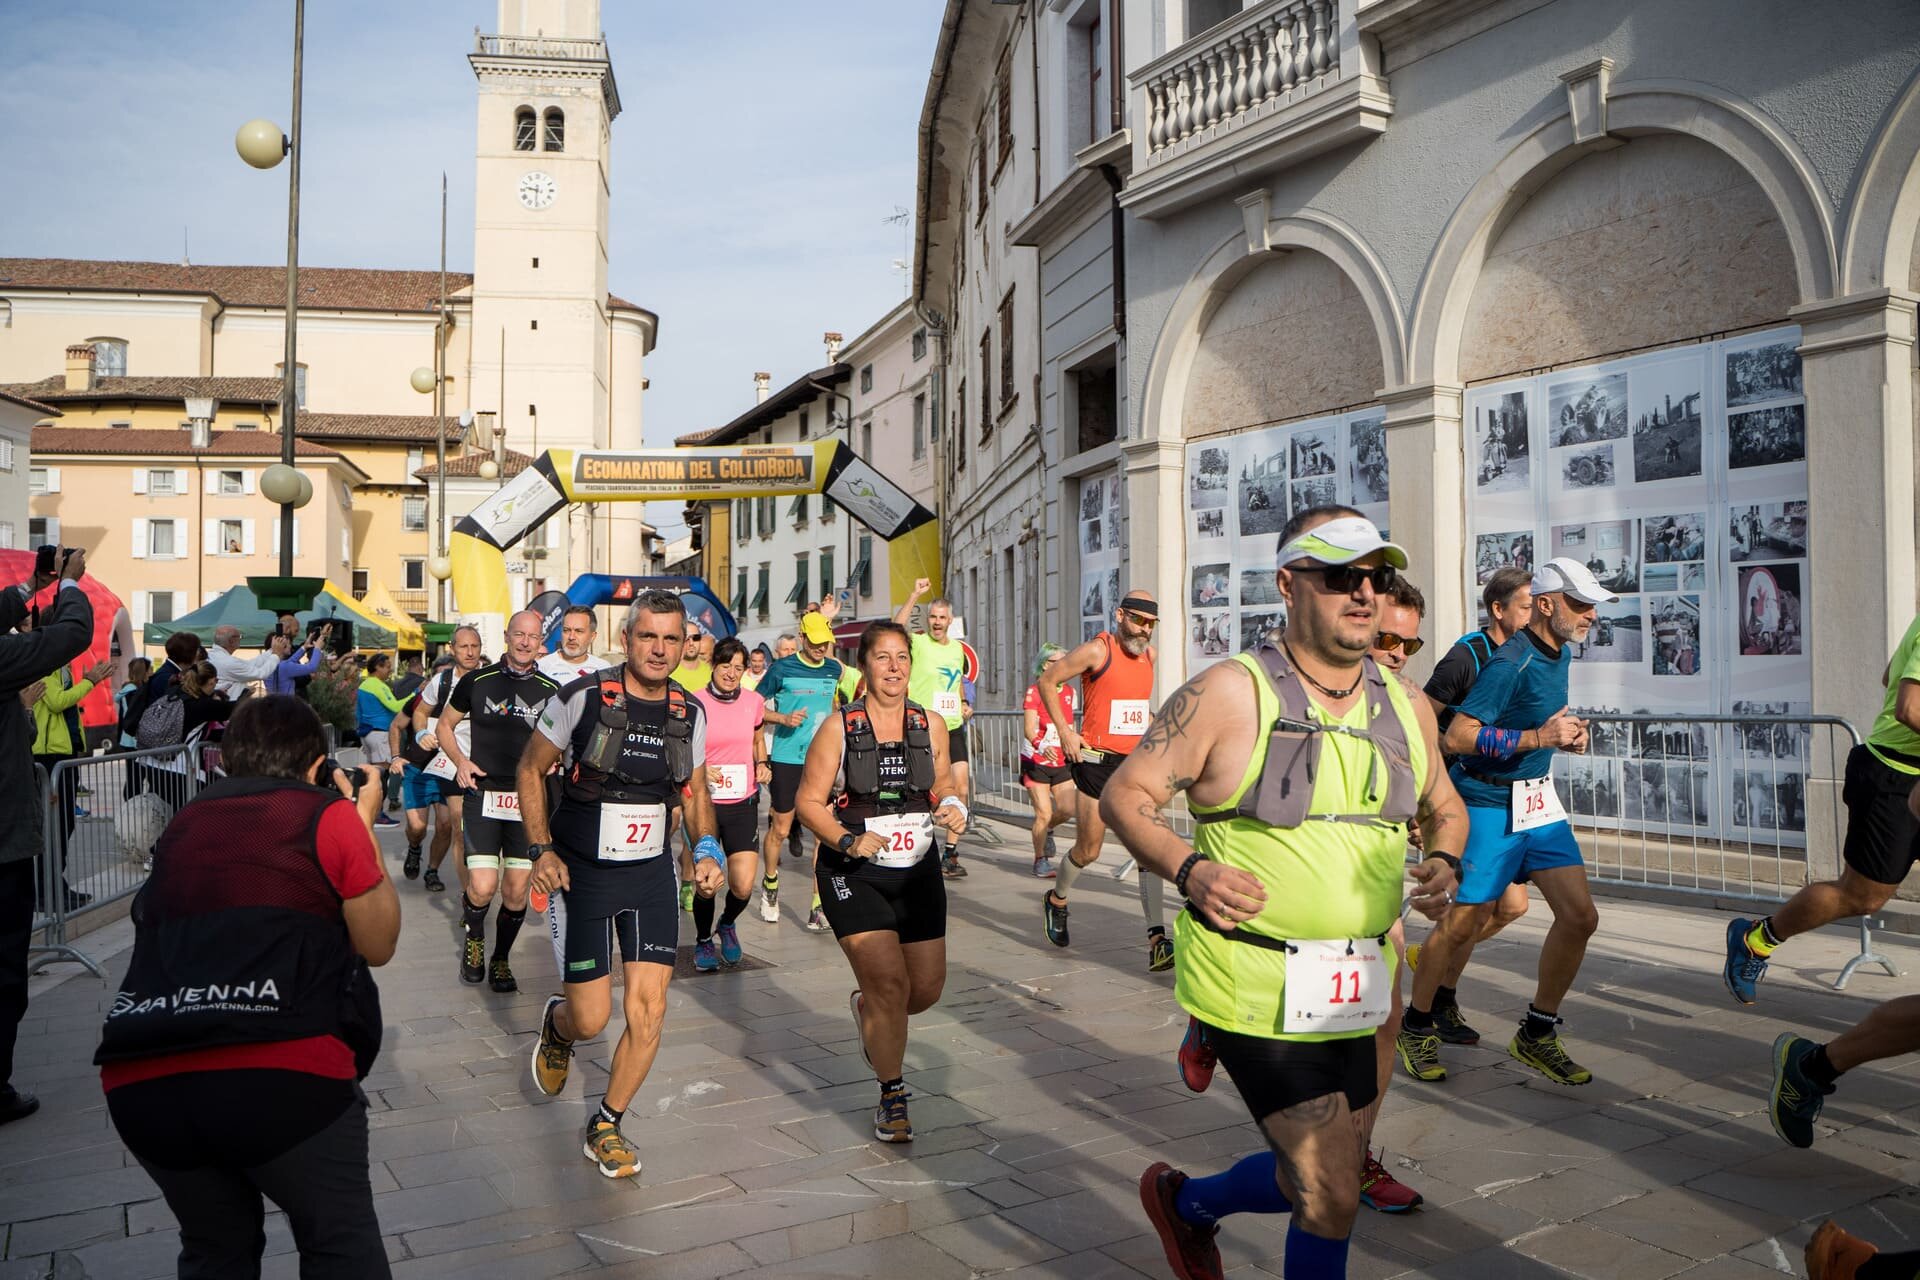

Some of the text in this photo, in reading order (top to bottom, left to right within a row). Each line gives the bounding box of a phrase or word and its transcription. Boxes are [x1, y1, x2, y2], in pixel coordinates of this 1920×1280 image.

[940, 699, 955, 709] 110
[1122, 711, 1143, 724] 148
[433, 758, 447, 769] 23
[626, 823, 652, 844] 27
[892, 831, 915, 852] 26
[1328, 971, 1362, 1004] 11
